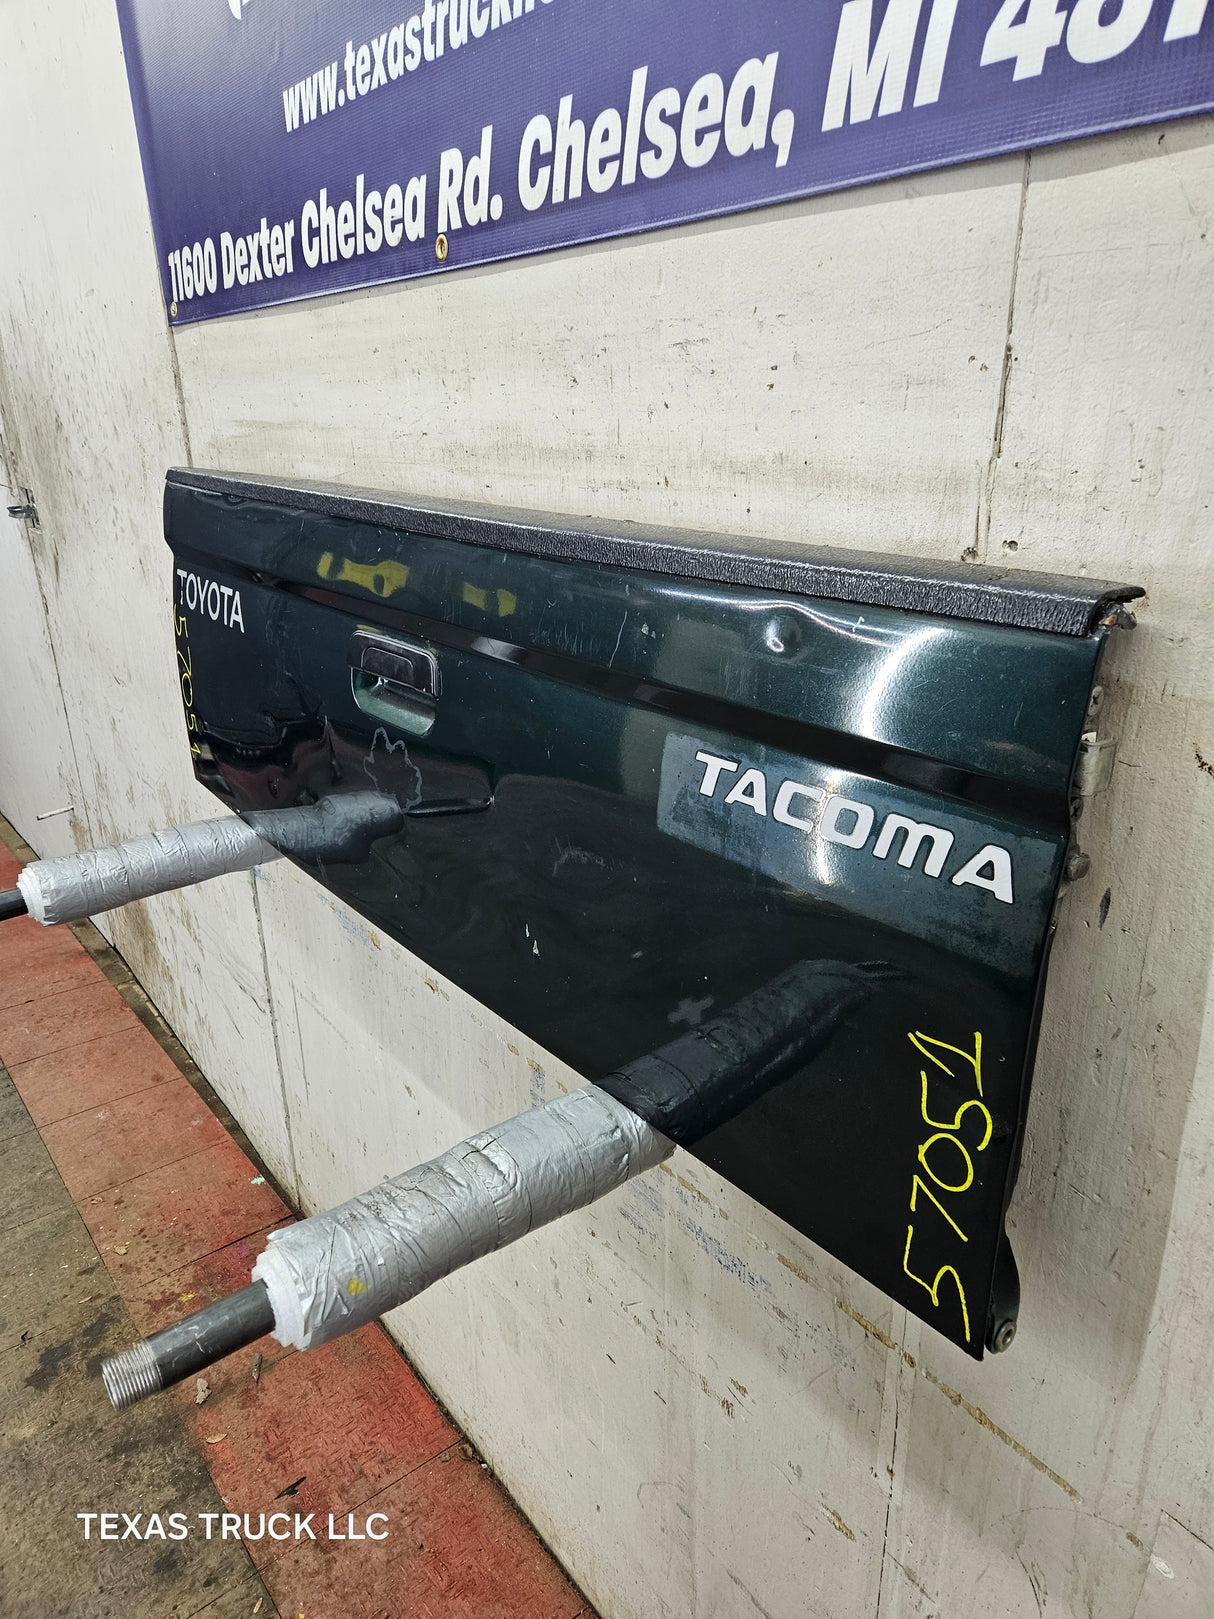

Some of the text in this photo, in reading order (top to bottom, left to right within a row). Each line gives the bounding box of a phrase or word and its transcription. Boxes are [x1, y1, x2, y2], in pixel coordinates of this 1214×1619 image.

[282, 0, 550, 132] www.texastruc
[168, 236, 218, 302] 11600
[220, 217, 295, 290] Dexter
[301, 174, 426, 269] Chelsea
[437, 124, 503, 233] Rd.
[518, 51, 795, 212] Chelsea,
[821, 0, 957, 132] MI
[176, 568, 245, 633] TOYOTA
[173, 603, 202, 759] 57051
[695, 750, 1014, 905] TACOMA
[903, 1030, 993, 1343] 57051
